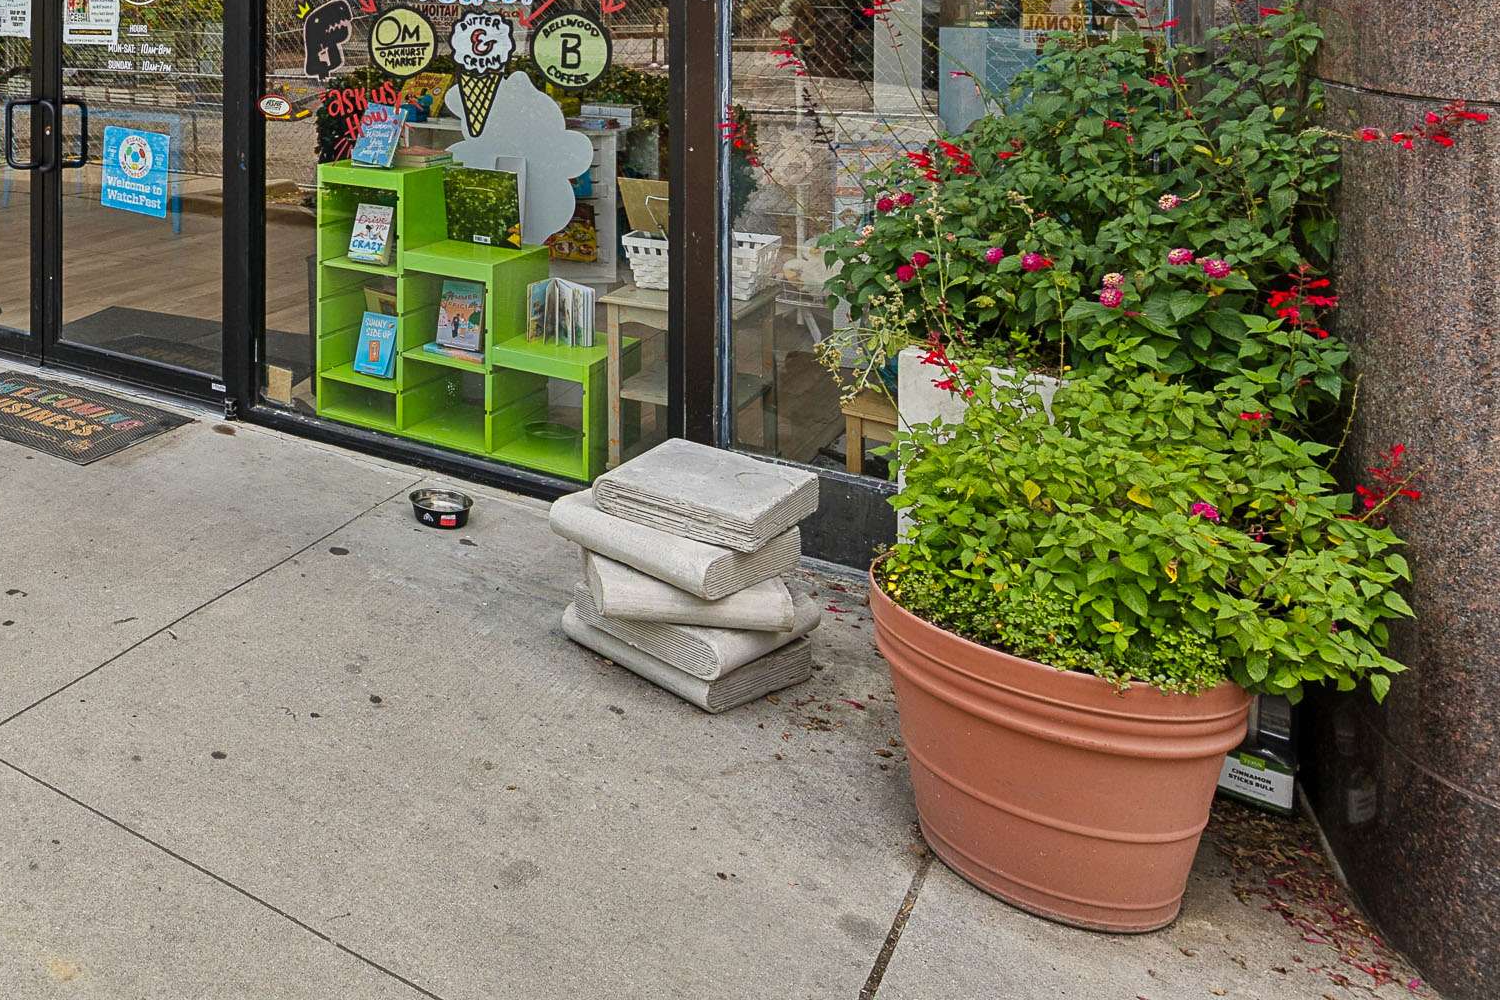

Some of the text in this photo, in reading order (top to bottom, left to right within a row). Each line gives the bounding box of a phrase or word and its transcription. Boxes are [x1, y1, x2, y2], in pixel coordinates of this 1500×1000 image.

[129, 24, 148, 34] HOURS
[376, 16, 420, 46] OM
[461, 16, 501, 31] BUTTER
[542, 18, 600, 38] BELLWOOD
[380, 47, 426, 58] OAKHURST
[561, 33, 581, 69] B
[385, 57, 425, 69] MARKET
[463, 54, 501, 68] CREAM
[547, 65, 589, 84] COFFEE
[107, 175, 162, 195] Welcome to
[107, 188, 162, 209] WatchFest
[352, 238, 383, 252] CRAZY
[365, 317, 388, 327] SUNNY
[365, 328, 393, 339] SIDE UP
[1228, 772, 1254, 786] STICKS
[1255, 781, 1275, 793] BULK
[1232, 767, 1272, 785] CINNAMON
